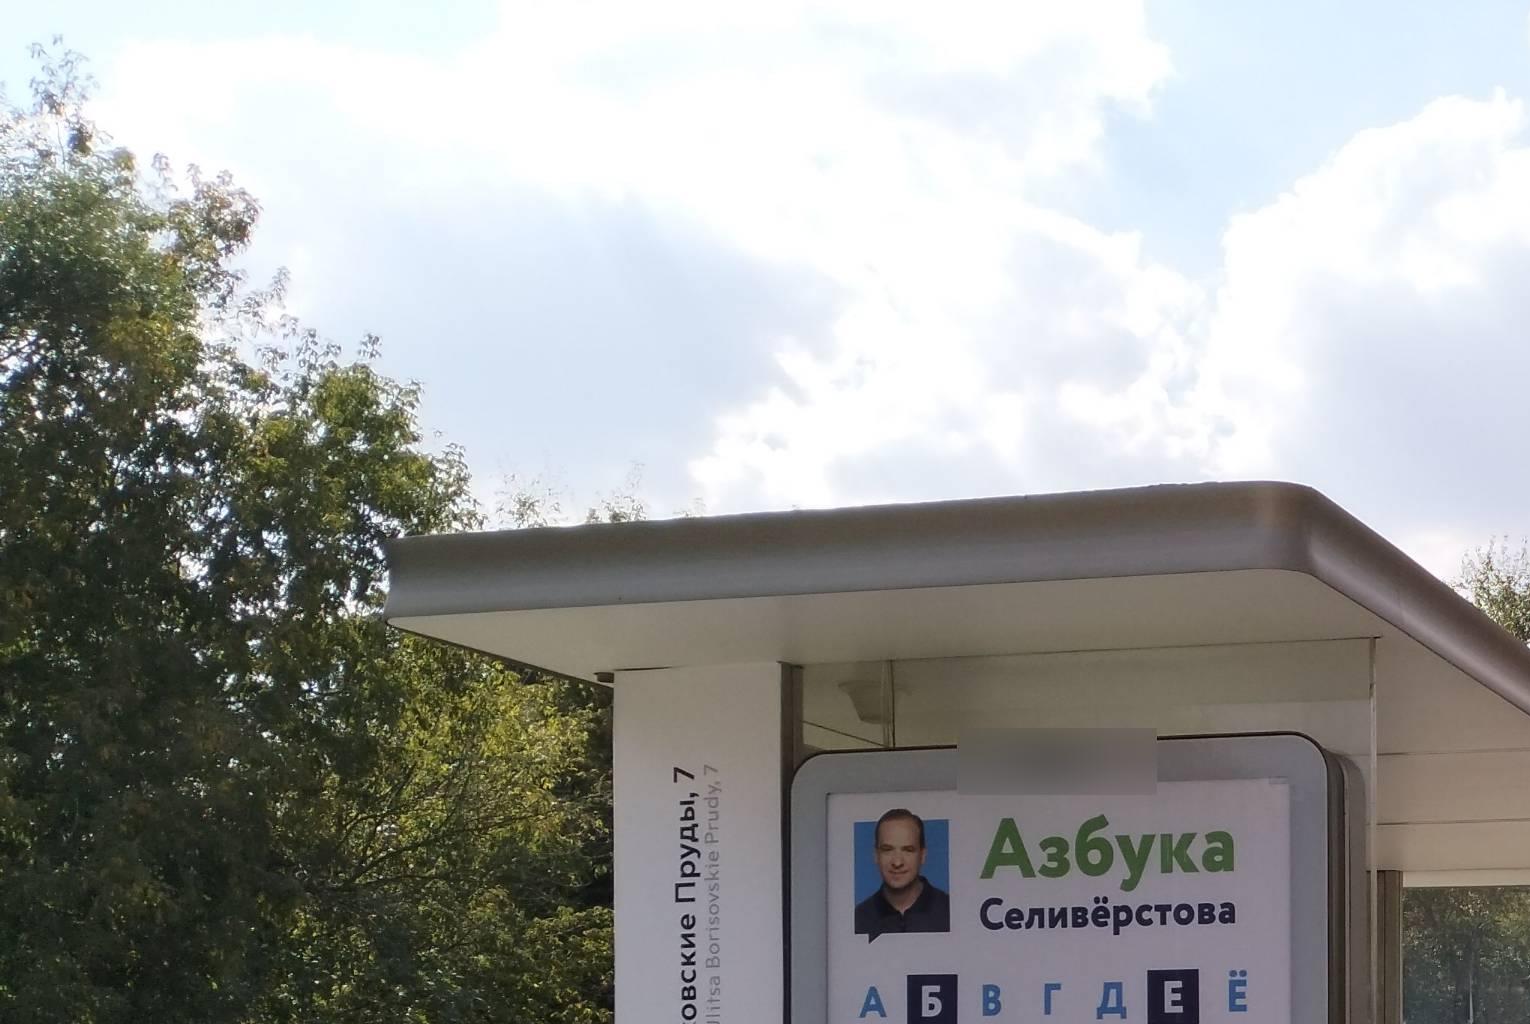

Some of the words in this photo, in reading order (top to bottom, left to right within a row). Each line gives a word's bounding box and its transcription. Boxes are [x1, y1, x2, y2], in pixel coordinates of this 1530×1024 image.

[673, 767, 695, 783] 7
[704, 764, 718, 775] 7
[704, 781, 722, 842] Prudy,
[675, 792, 700, 902] Пруды,
[980, 814, 1234, 892] Азбука
[706, 852, 720, 968] Borisovskie
[980, 897, 1236, 935] Селивёрстова
[859, 986, 887, 1018] А
[921, 986, 942, 1017] Б
[982, 984, 1001, 1016] В
[1044, 983, 1061, 1015] Г
[1096, 981, 1127, 1020] Д
[1164, 981, 1183, 1013] Е
[1228, 969, 1248, 1012] Ё
